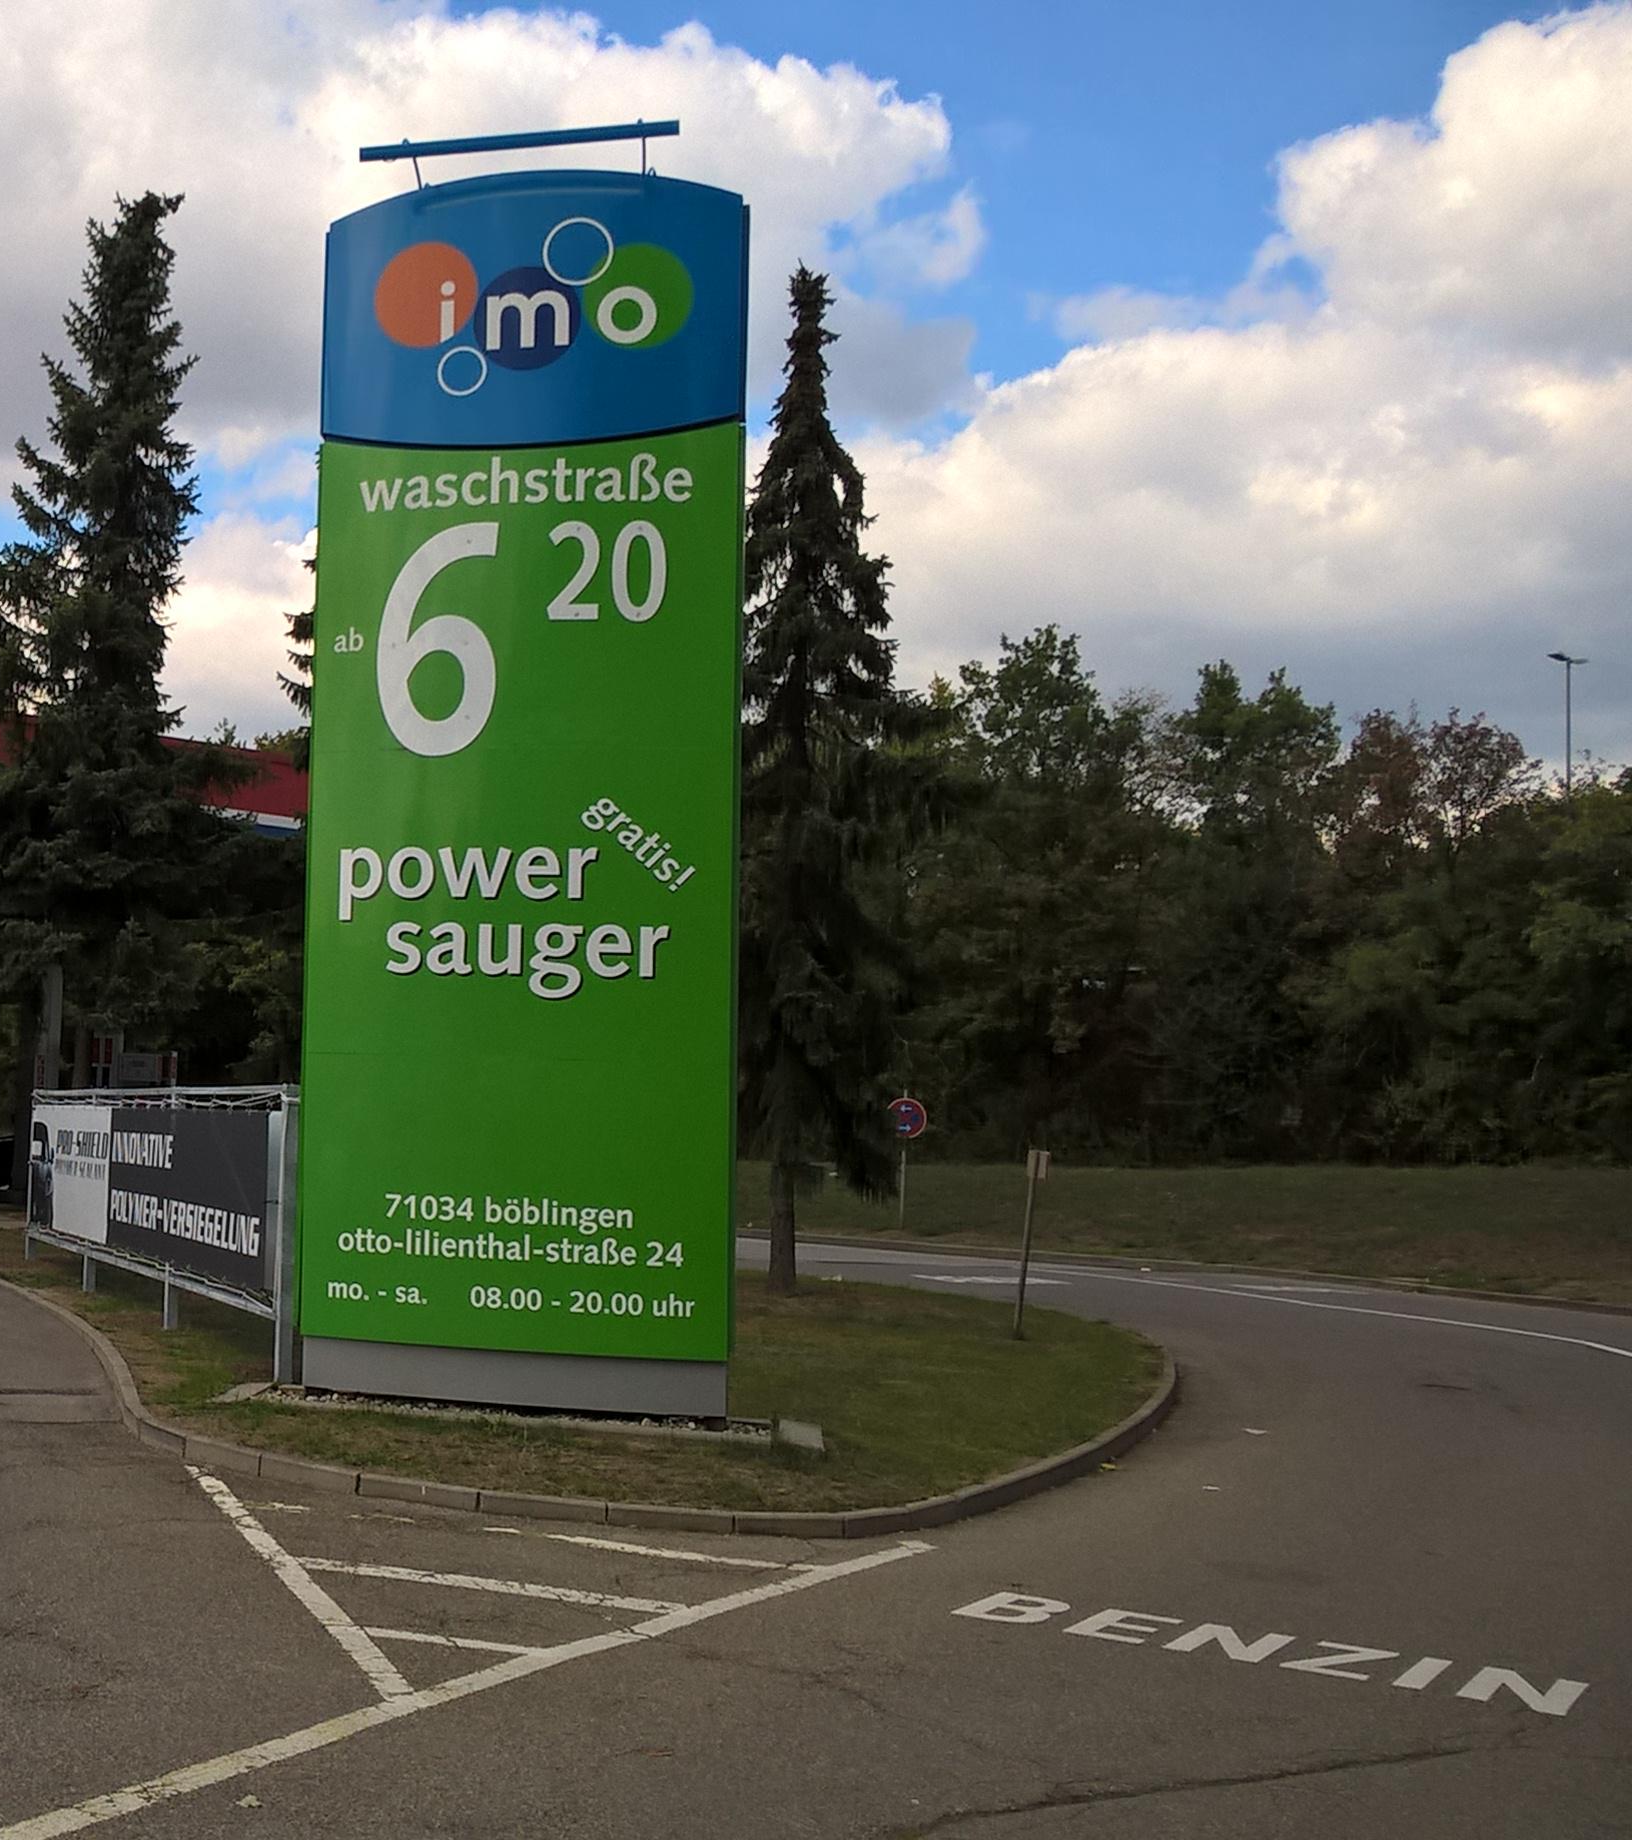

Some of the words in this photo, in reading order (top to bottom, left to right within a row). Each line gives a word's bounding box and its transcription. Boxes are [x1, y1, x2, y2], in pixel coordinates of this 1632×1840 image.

[439, 280, 658, 351] imo
[359, 453, 694, 512] waschstraße
[333, 626, 365, 655] ab
[376, 521, 500, 758] 6
[546, 519, 668, 623] 20
[581, 797, 696, 892] gratis!
[337, 845, 599, 922] power
[385, 920, 671, 1000] sauger
[56, 1129, 109, 1160] PRO-SHIELD
[112, 1131, 174, 1169] INNOVATIVE
[110, 1188, 261, 1258] POLYMER-VERSIEGELUNG
[338, 1227, 637, 1267] otto-lilienthal-straße
[645, 1241, 684, 1268] 24
[384, 1193, 474, 1222] 71034
[485, 1195, 634, 1235] böblingen
[327, 1280, 369, 1301] mo.
[395, 1285, 428, 1305] sa.
[470, 1285, 542, 1311] 08.00
[569, 1290, 643, 1316] 20.00
[652, 1292, 695, 1318] uhr
[950, 1591, 1590, 1717] BENZIN
